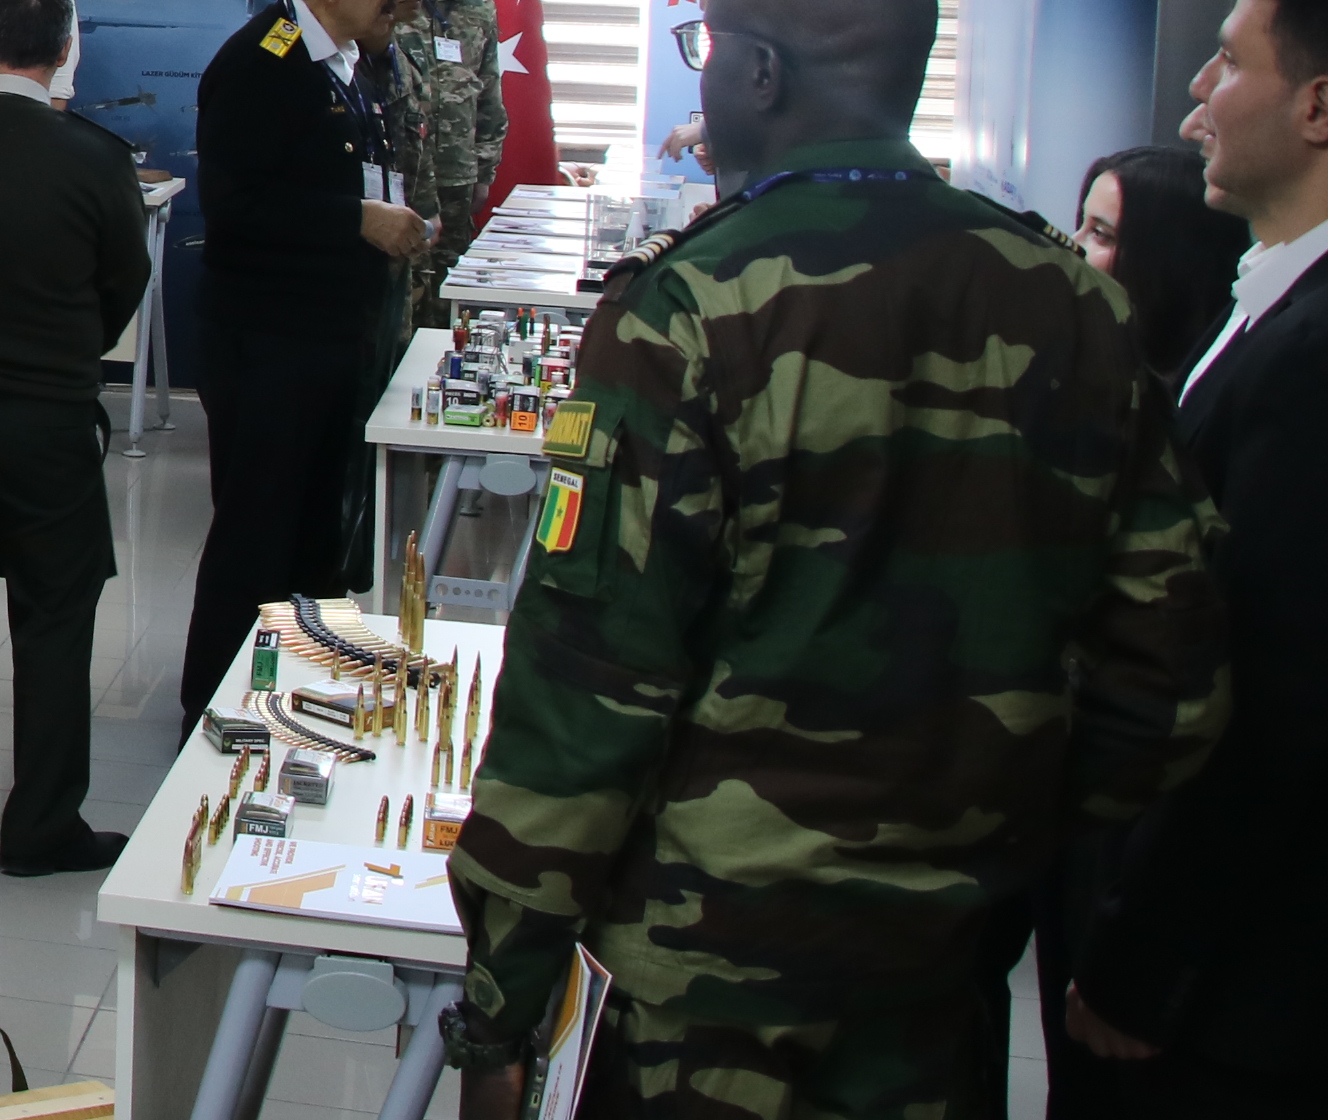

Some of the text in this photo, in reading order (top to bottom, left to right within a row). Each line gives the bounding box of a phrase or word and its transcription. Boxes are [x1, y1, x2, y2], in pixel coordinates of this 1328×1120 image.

[165, 70, 190, 78] GÜDÜM
[517, 414, 528, 427] 10
[553, 472, 579, 488] SENEGAL
[249, 823, 269, 833] FMJ
[440, 825, 458, 834] FMJ
